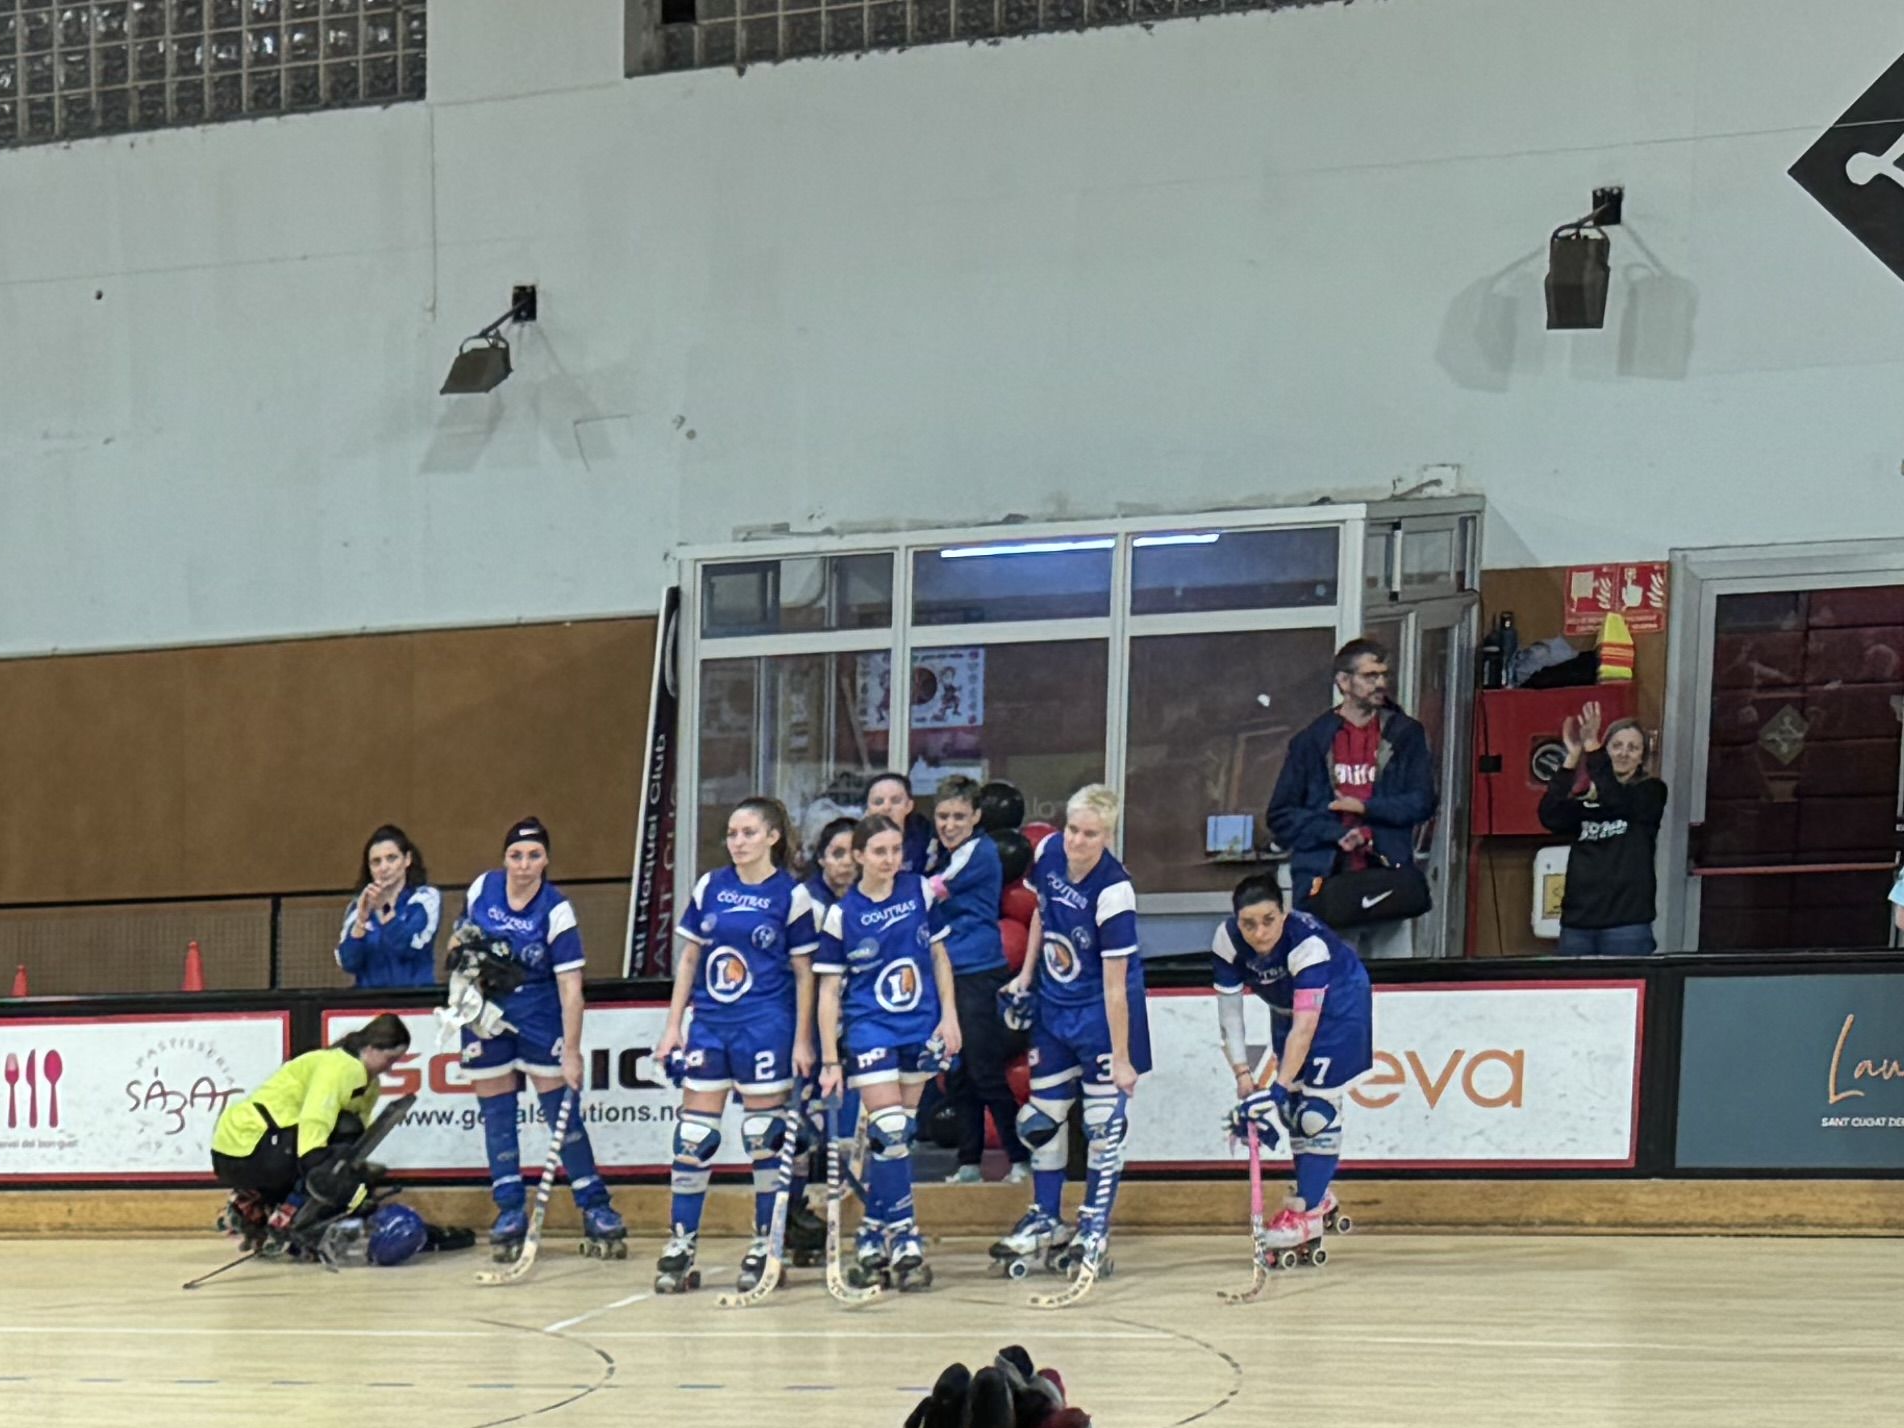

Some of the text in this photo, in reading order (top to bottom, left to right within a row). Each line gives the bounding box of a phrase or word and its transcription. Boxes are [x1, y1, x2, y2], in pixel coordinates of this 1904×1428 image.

[716, 889, 771, 910] COUTRAS
[860, 898, 918, 927] COUTRAS
[754, 1050, 776, 1082] 2
[1095, 1053, 1114, 1082] 3
[1311, 1056, 1332, 1087] 7
